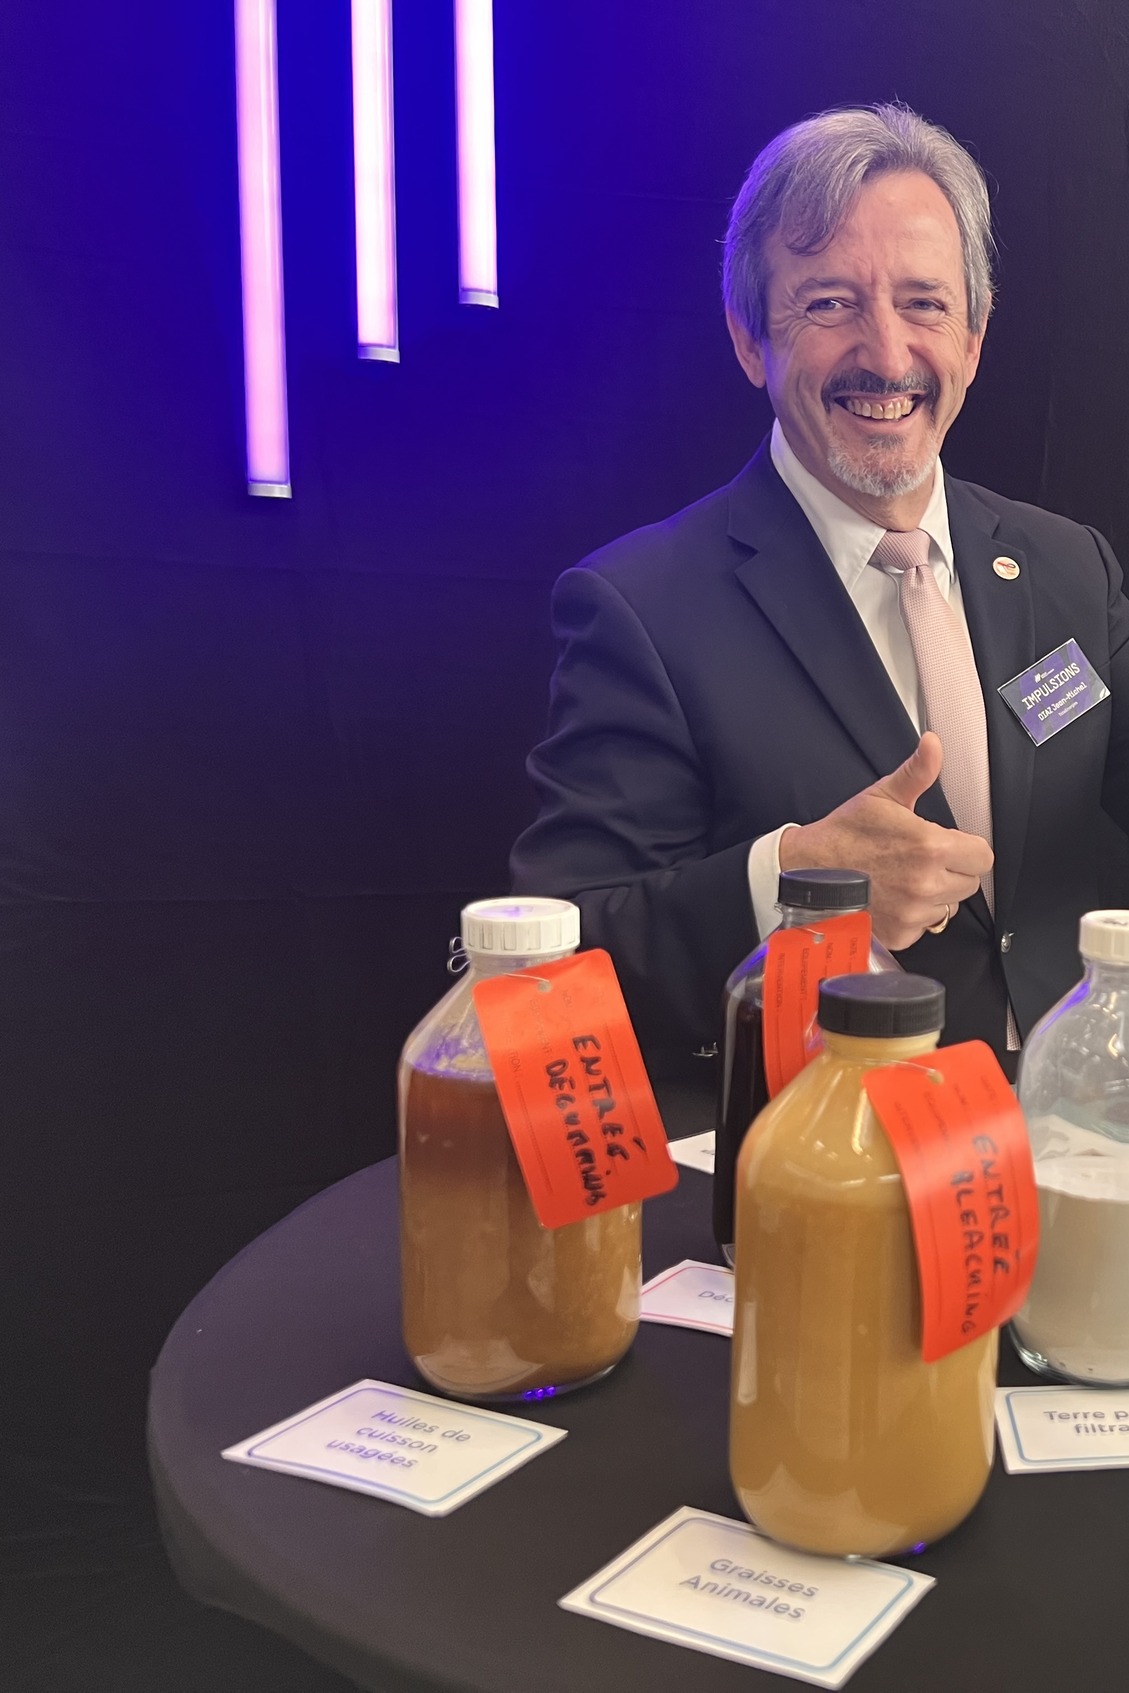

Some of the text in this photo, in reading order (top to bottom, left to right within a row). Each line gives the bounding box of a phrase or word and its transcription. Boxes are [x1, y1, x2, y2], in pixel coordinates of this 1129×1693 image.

[1021, 662, 1081, 710] IMPULSIONS
[1037, 706, 1054, 721] DIAZ
[1051, 681, 1088, 711] Jean-Michel
[371, 1409, 472, 1443] Huiles de
[1043, 1409, 1106, 1421] Terre
[325, 1438, 418, 1469] usagées
[355, 1425, 440, 1454] cuisson
[709, 1557, 820, 1599] Graisses
[679, 1574, 806, 1620] Animales
